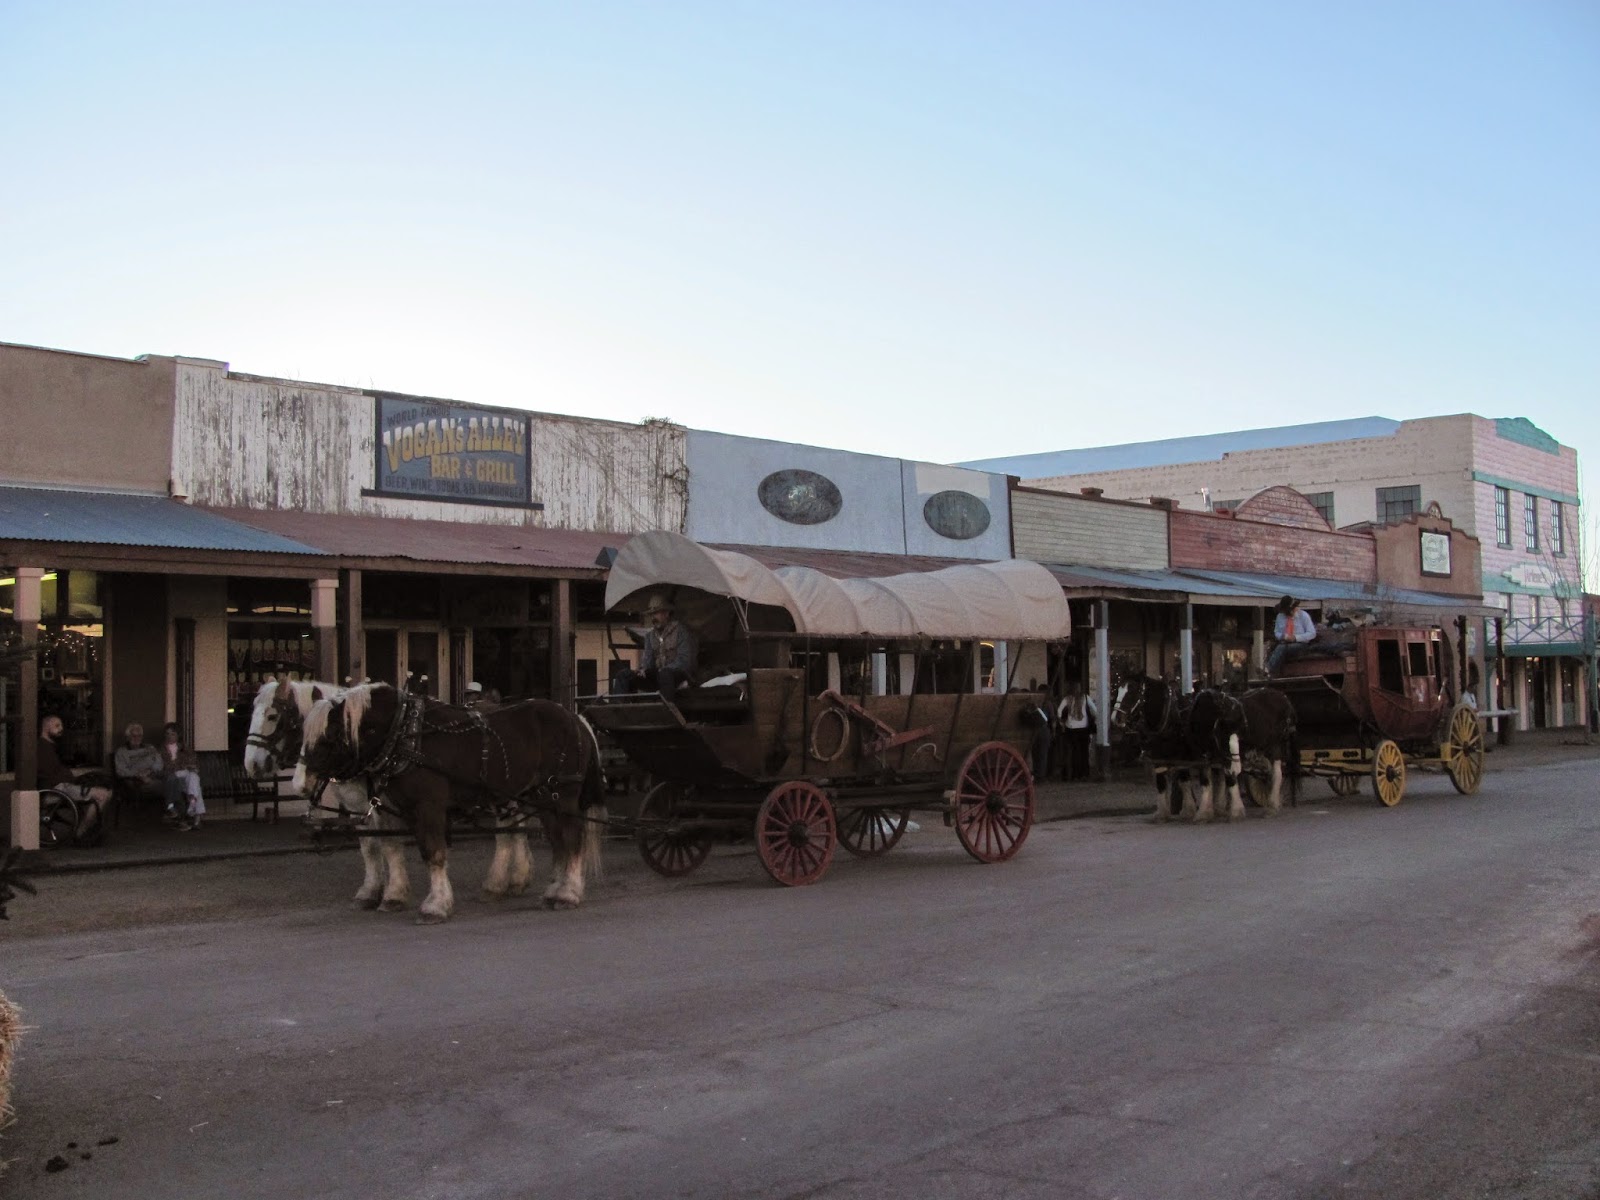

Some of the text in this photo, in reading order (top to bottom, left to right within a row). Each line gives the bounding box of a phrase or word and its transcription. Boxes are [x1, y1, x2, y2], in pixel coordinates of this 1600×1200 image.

[387, 405, 451, 427] WORLD FAMOUS
[466, 416, 526, 457] ALLEY
[431, 454, 461, 480] BAR
[477, 459, 516, 484] GRILL
